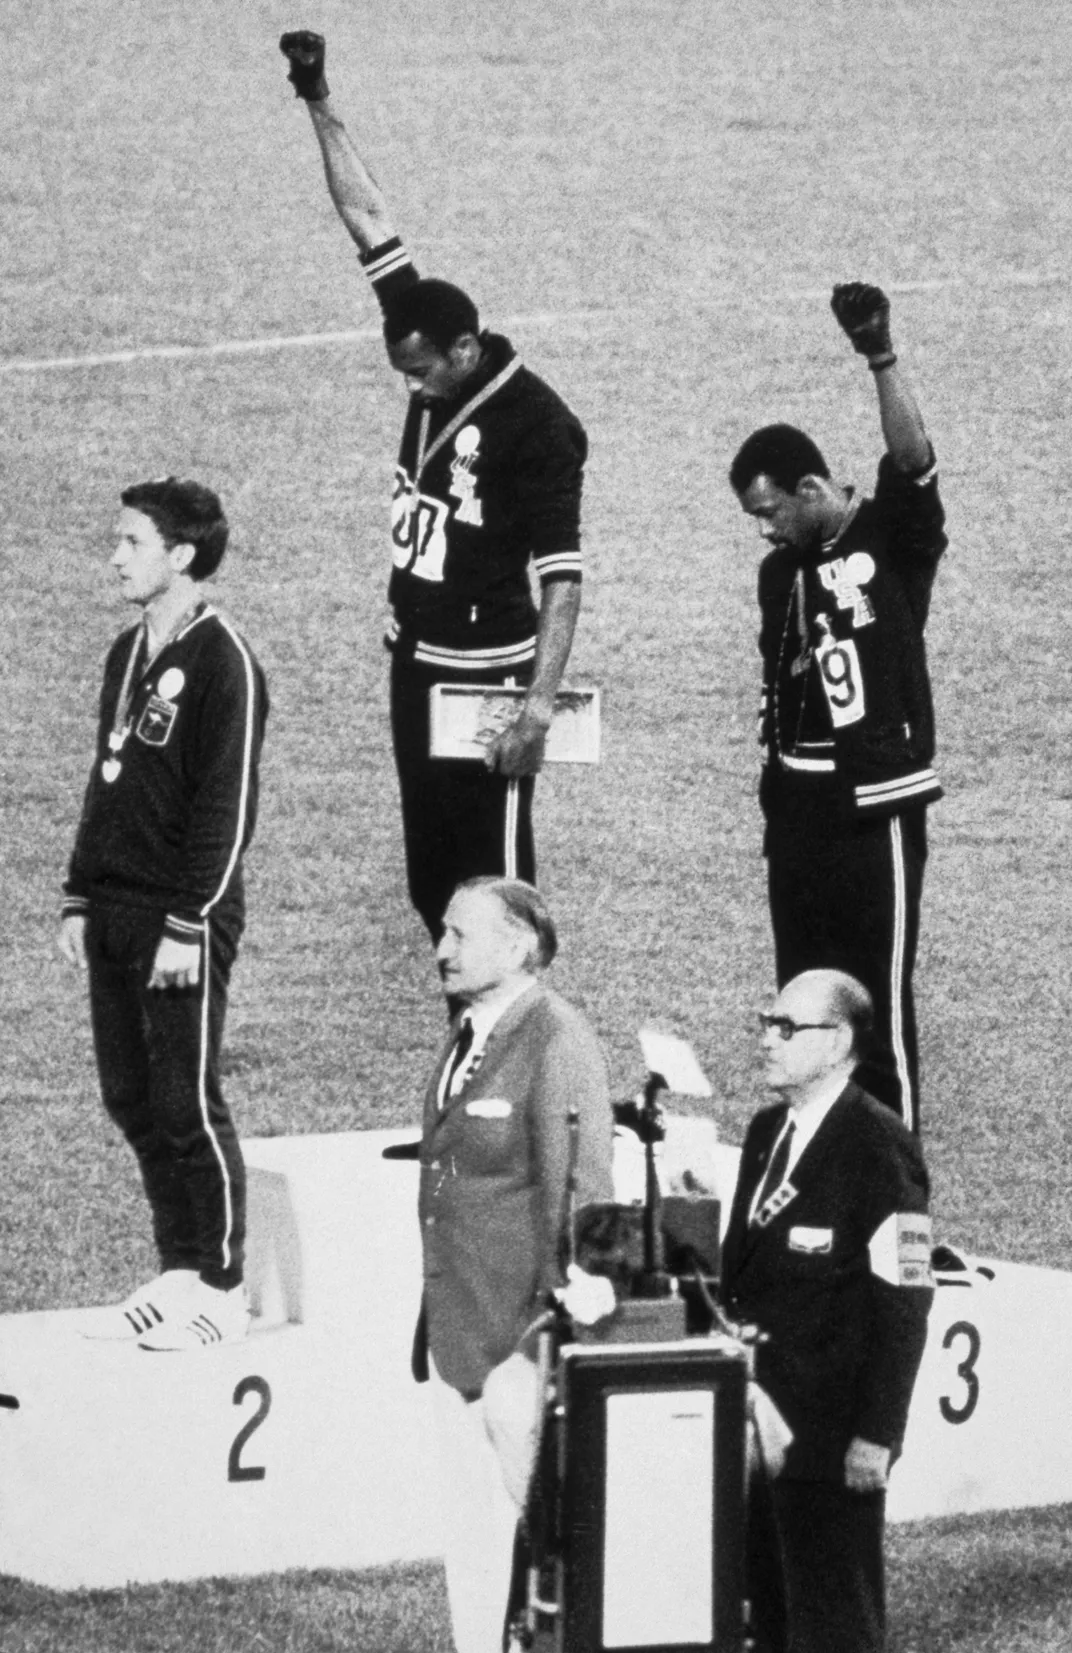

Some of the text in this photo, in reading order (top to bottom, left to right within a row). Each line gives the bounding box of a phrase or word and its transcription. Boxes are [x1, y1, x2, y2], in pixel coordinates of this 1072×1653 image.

[820, 646, 857, 710] 9
[939, 1320, 981, 1425] 3
[227, 1374, 272, 1483] 2
